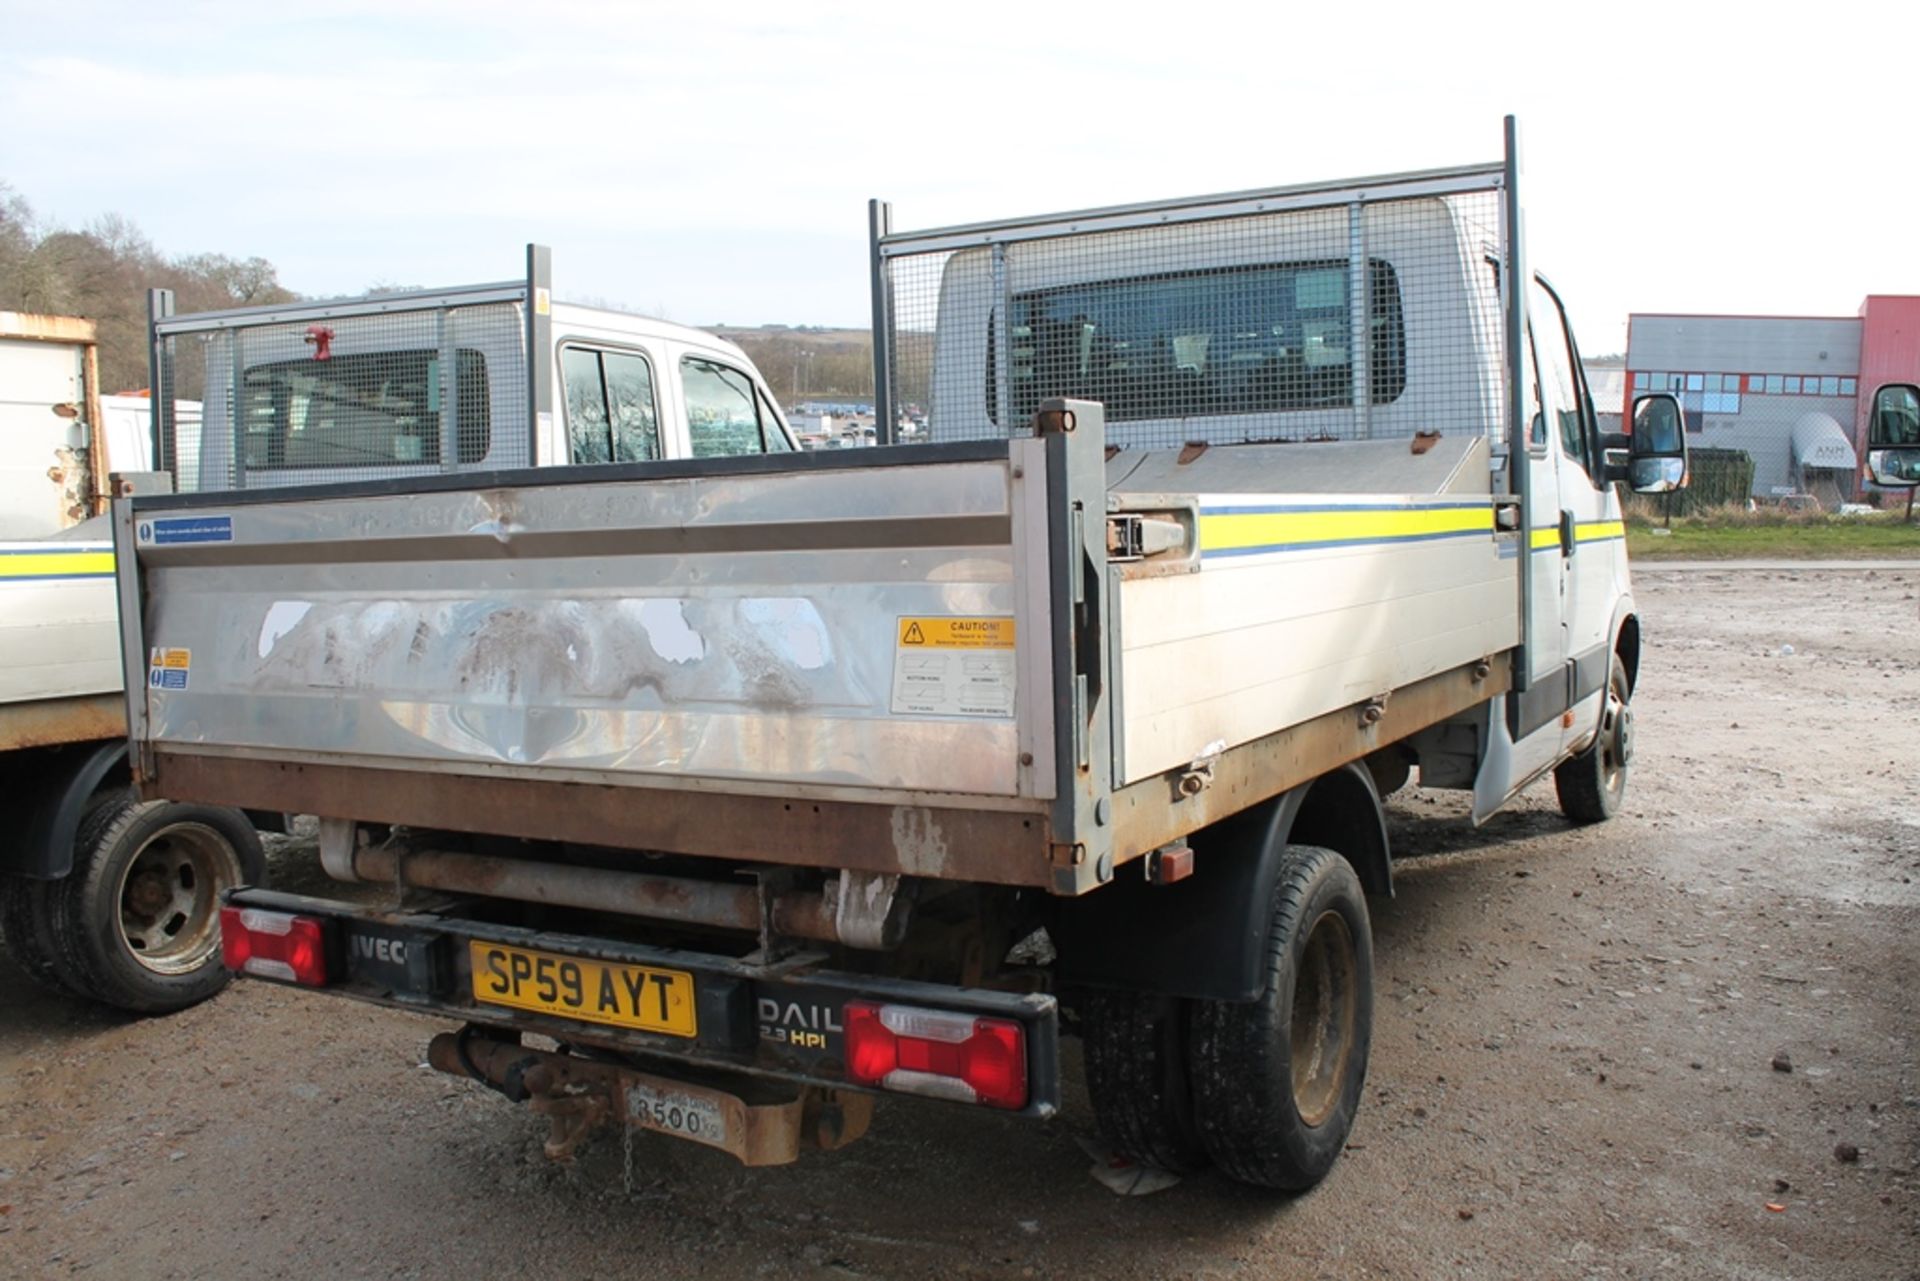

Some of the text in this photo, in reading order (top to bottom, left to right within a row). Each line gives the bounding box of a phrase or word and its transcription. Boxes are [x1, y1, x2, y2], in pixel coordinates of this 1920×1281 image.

[950, 621, 1000, 632] CAUTION!
[352, 934, 408, 965] IVEC
[487, 948, 674, 1022] SP59 AYT
[758, 997, 844, 1033] DAIL
[790, 1029, 826, 1050] HPI
[637, 1098, 700, 1133] 3500
